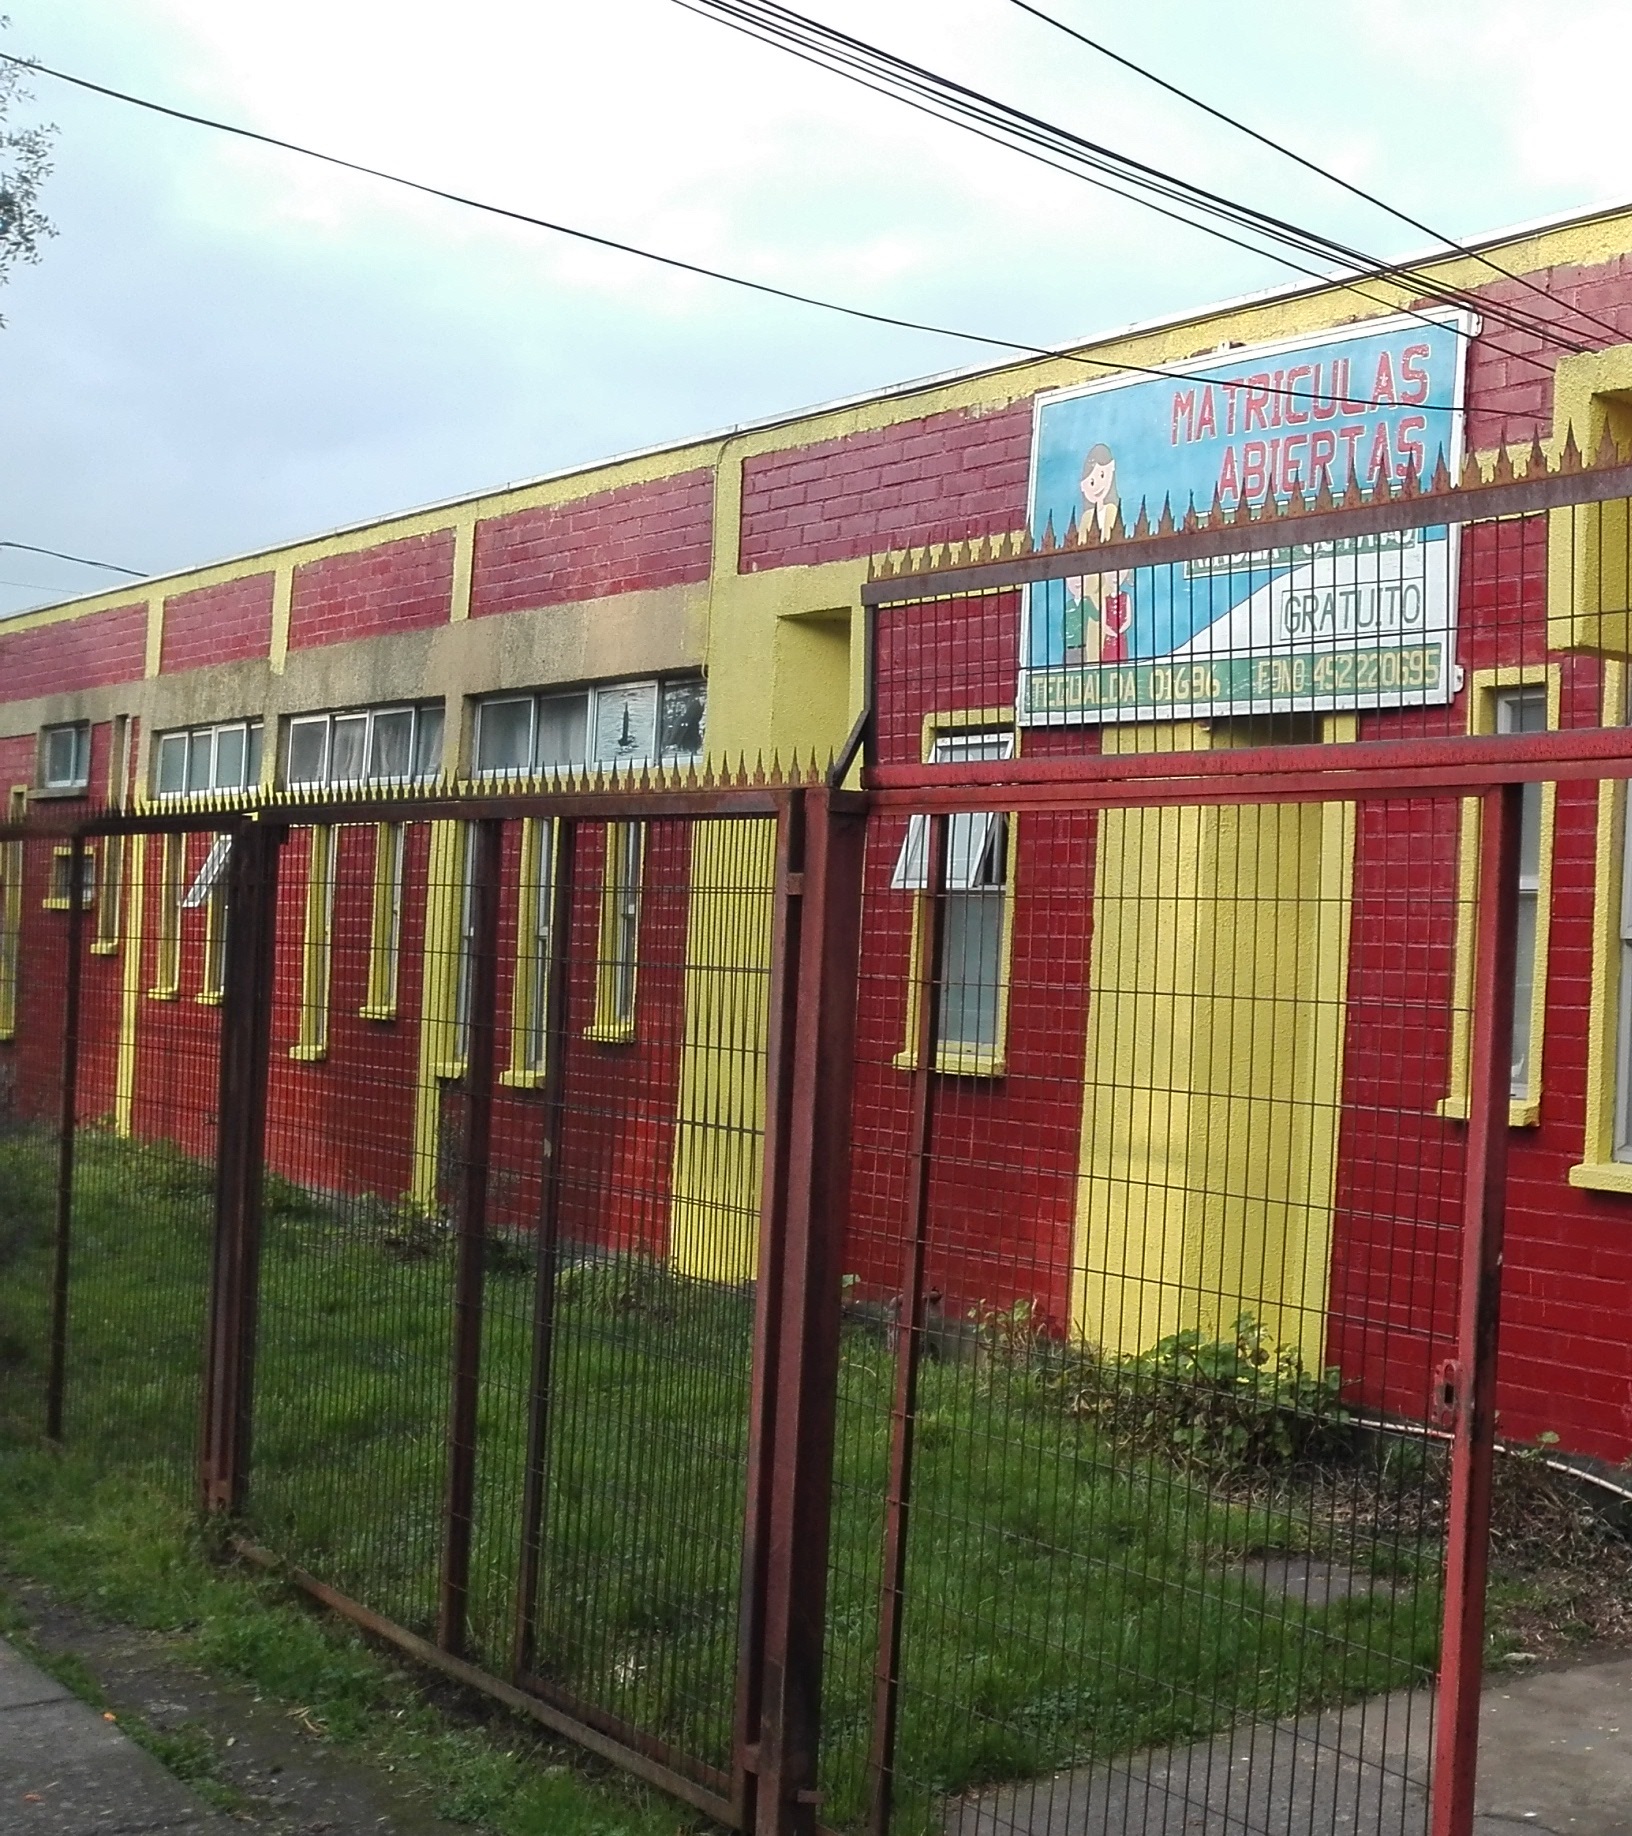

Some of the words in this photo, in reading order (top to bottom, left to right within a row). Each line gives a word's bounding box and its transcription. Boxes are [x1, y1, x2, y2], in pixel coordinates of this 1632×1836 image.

[1171, 343, 1430, 447] MATRICULAS
[1218, 415, 1427, 502] ABIERTAS
[1031, 671, 1135, 708] TEGUALDA
